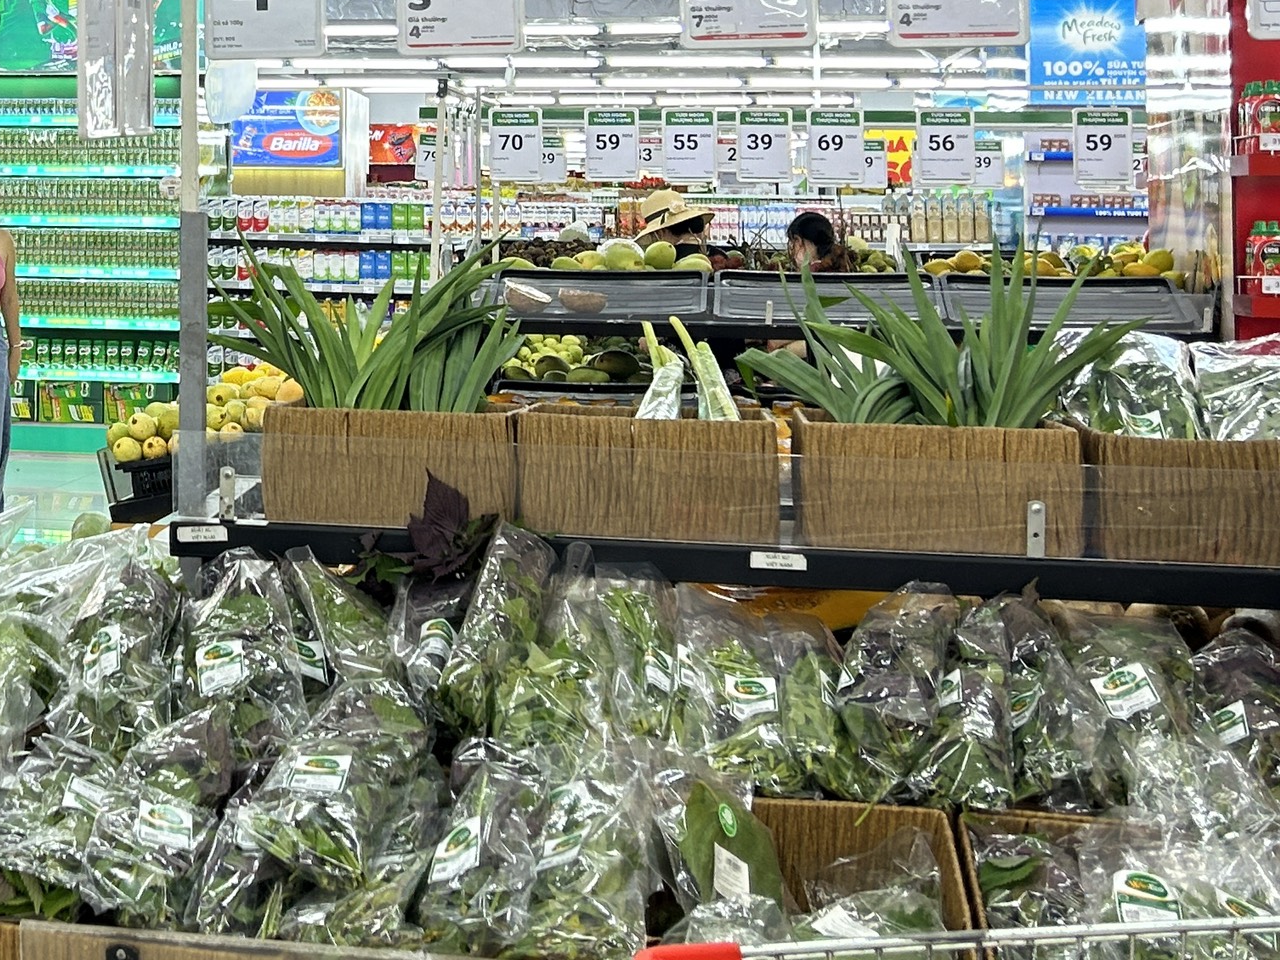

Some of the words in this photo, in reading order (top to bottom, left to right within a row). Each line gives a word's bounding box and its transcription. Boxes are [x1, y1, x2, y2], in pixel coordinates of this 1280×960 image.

[692, 15, 704, 28] 7
[899, 13, 912, 27] 4
[1062, 16, 1121, 39] Meadow
[409, 26, 421, 39] 4
[1083, 28, 1118, 45] Fresh
[1043, 60, 1105, 76] 100%
[1107, 58, 1128, 69] SỮA
[270, 136, 321, 151] Barilla
[498, 134, 523, 151] 70
[595, 134, 620, 150] 59
[673, 134, 698, 150] 55
[746, 133, 773, 150] 39
[817, 134, 843, 151] 69
[928, 134, 955, 151] 56
[1086, 134, 1112, 151] 59
